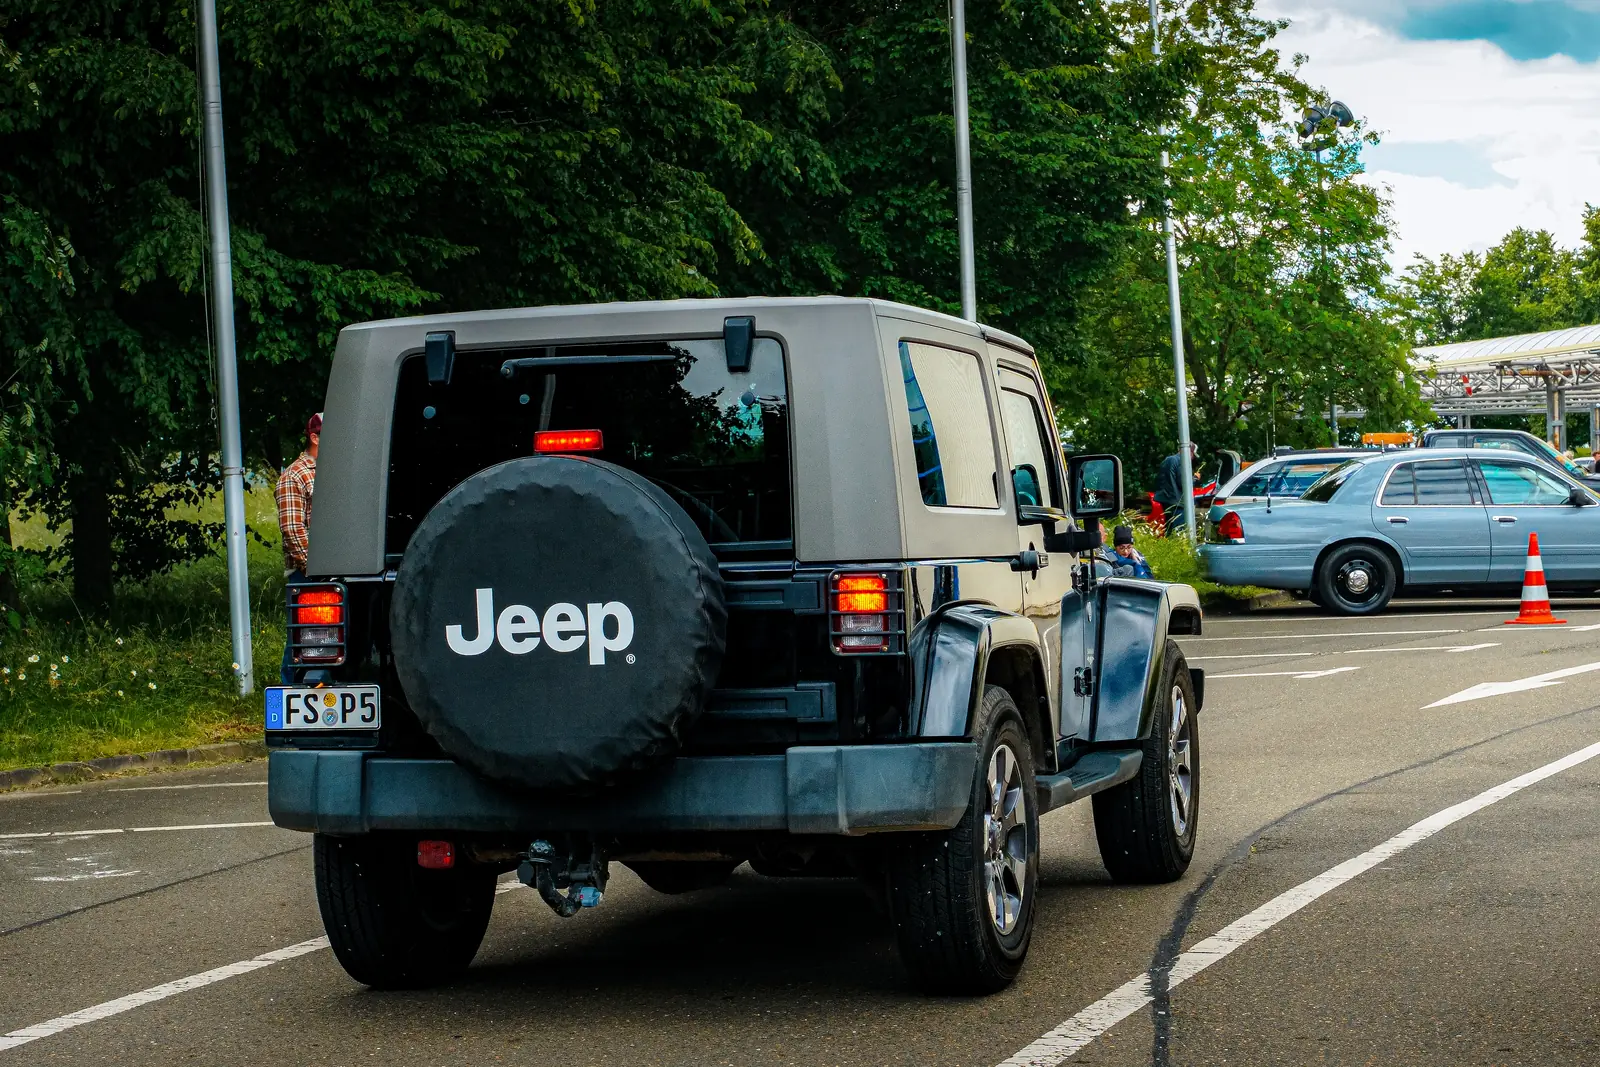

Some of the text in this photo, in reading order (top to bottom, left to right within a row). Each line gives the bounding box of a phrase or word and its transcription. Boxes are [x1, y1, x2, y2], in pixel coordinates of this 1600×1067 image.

[446, 588, 634, 665] Jeep
[271, 713, 278, 722] D
[286, 693, 319, 724] FS
